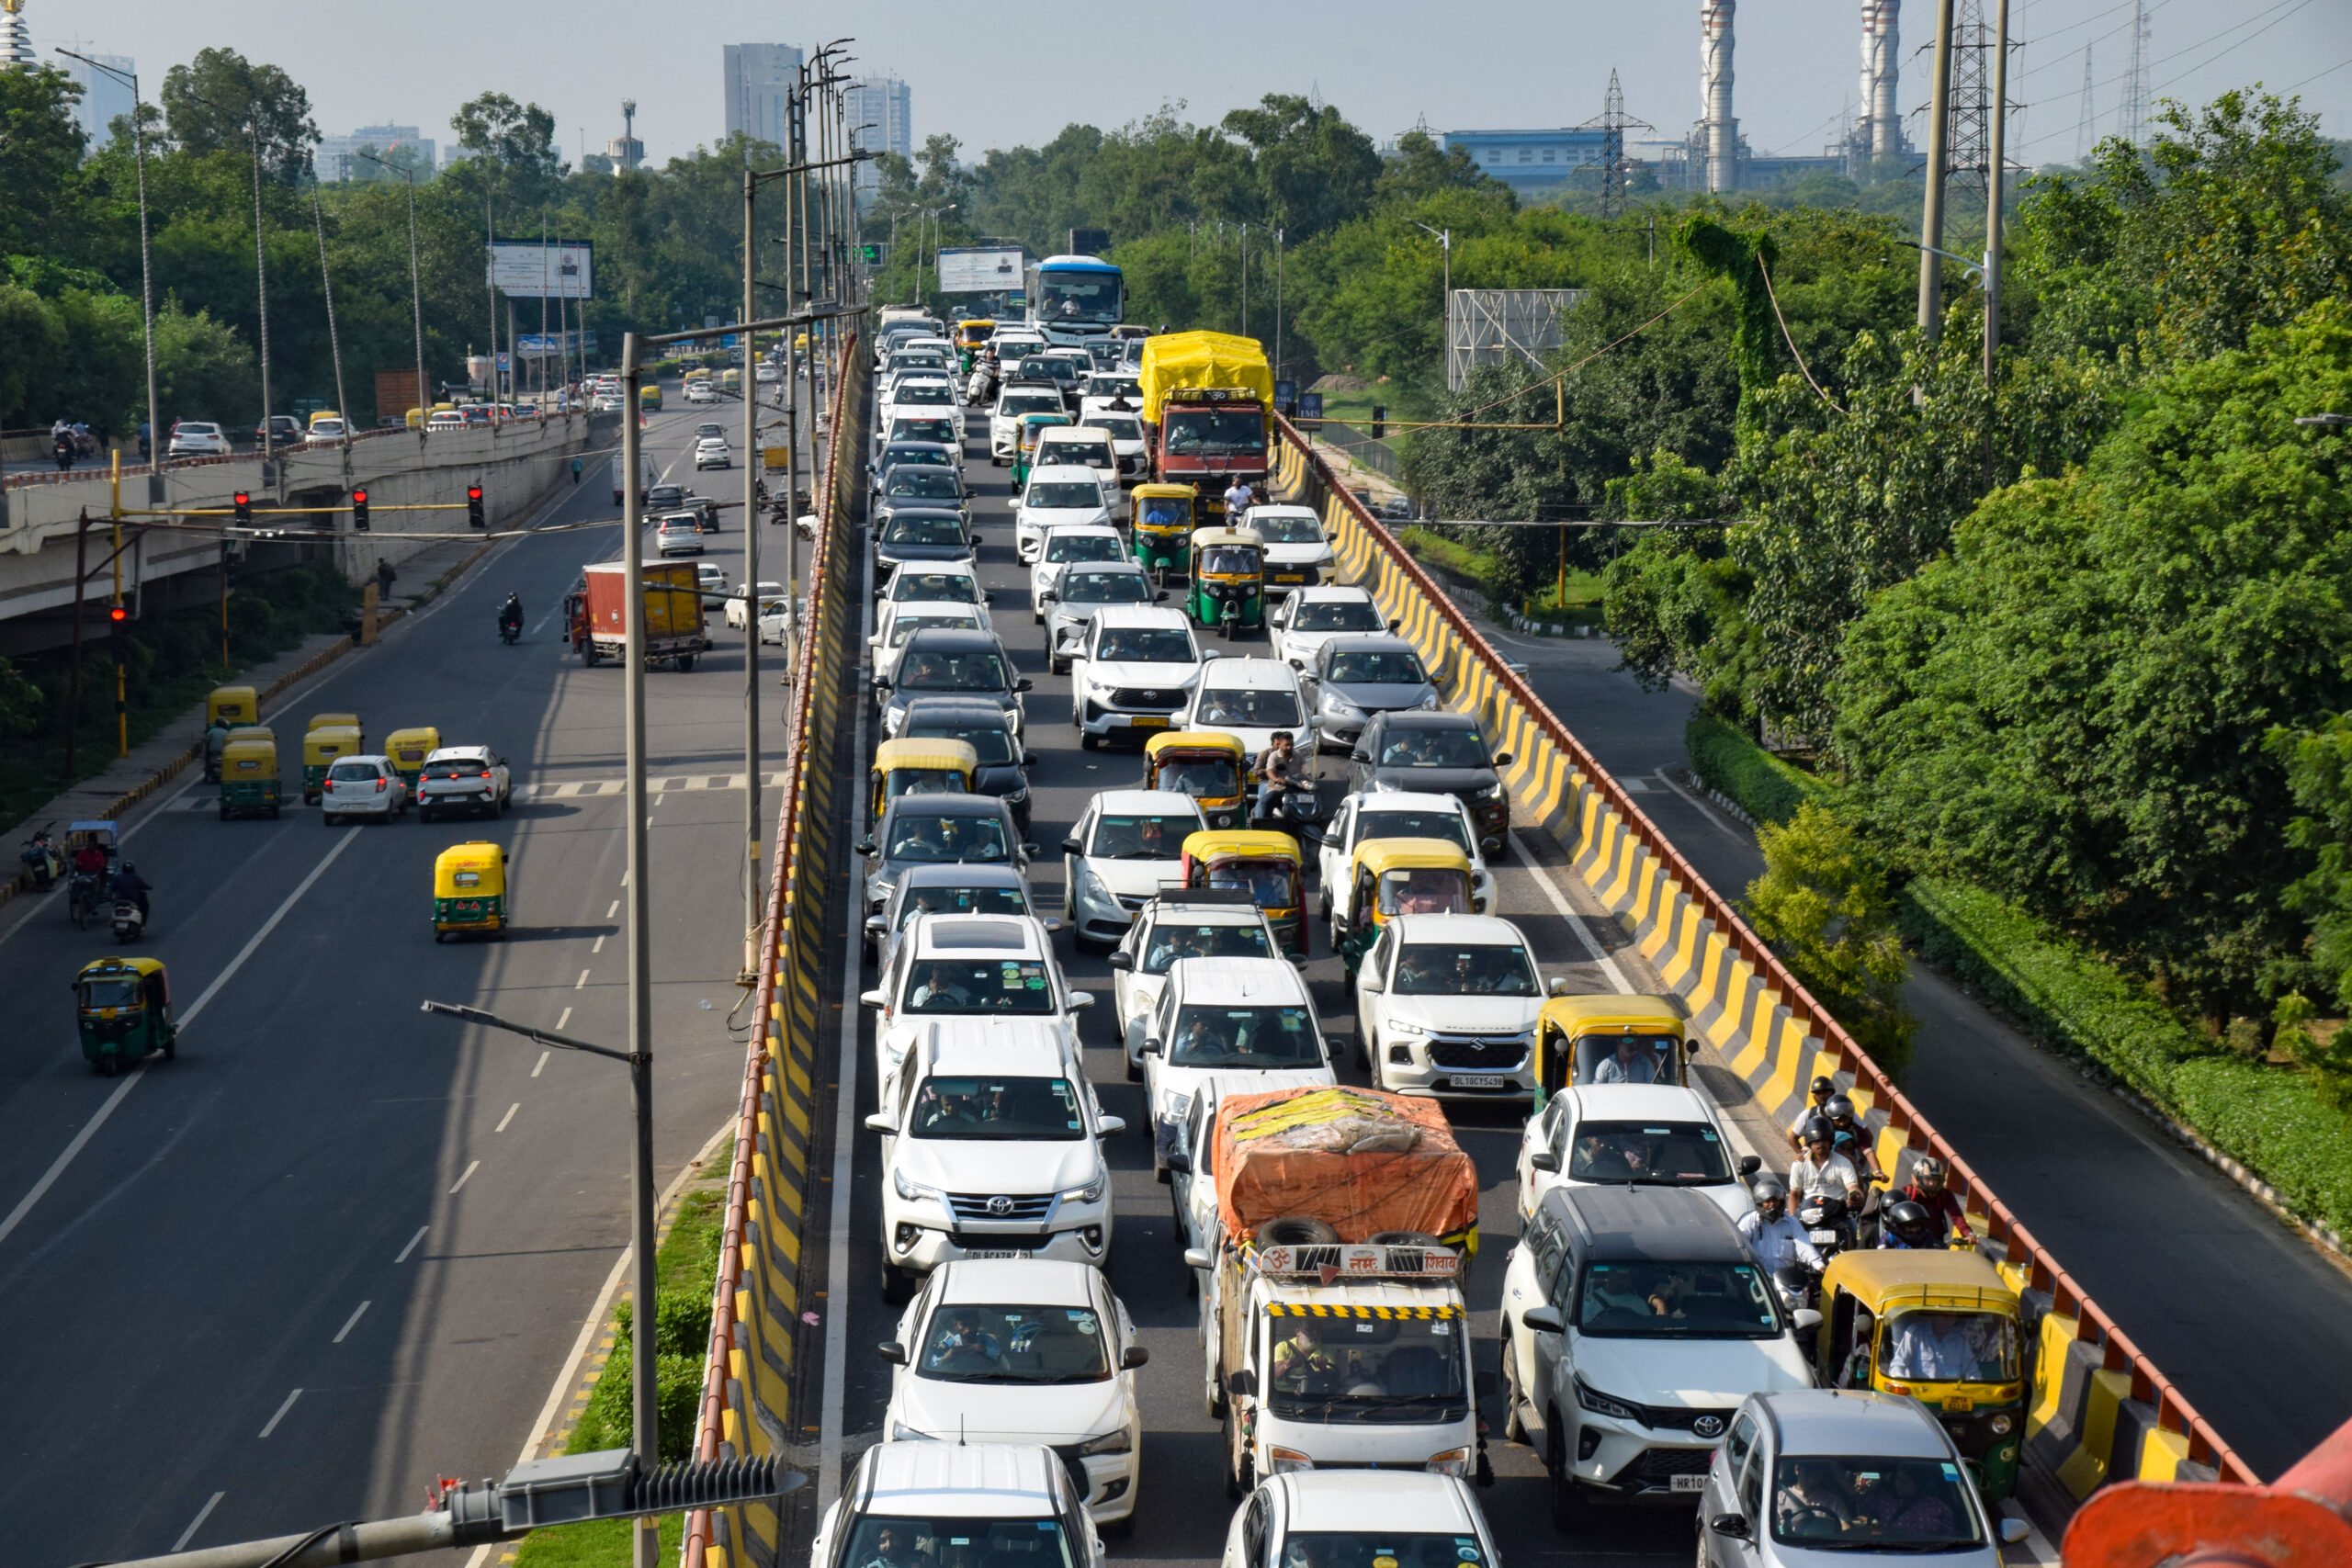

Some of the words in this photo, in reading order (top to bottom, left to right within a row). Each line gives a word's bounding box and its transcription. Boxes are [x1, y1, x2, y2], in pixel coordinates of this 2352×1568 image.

[1300, 410, 1320, 418] IMS
[1264, 1247, 1291, 1270] ॐ
[1350, 1258, 1378, 1270] नमः
[1424, 1252, 1457, 1269] शिवाय
